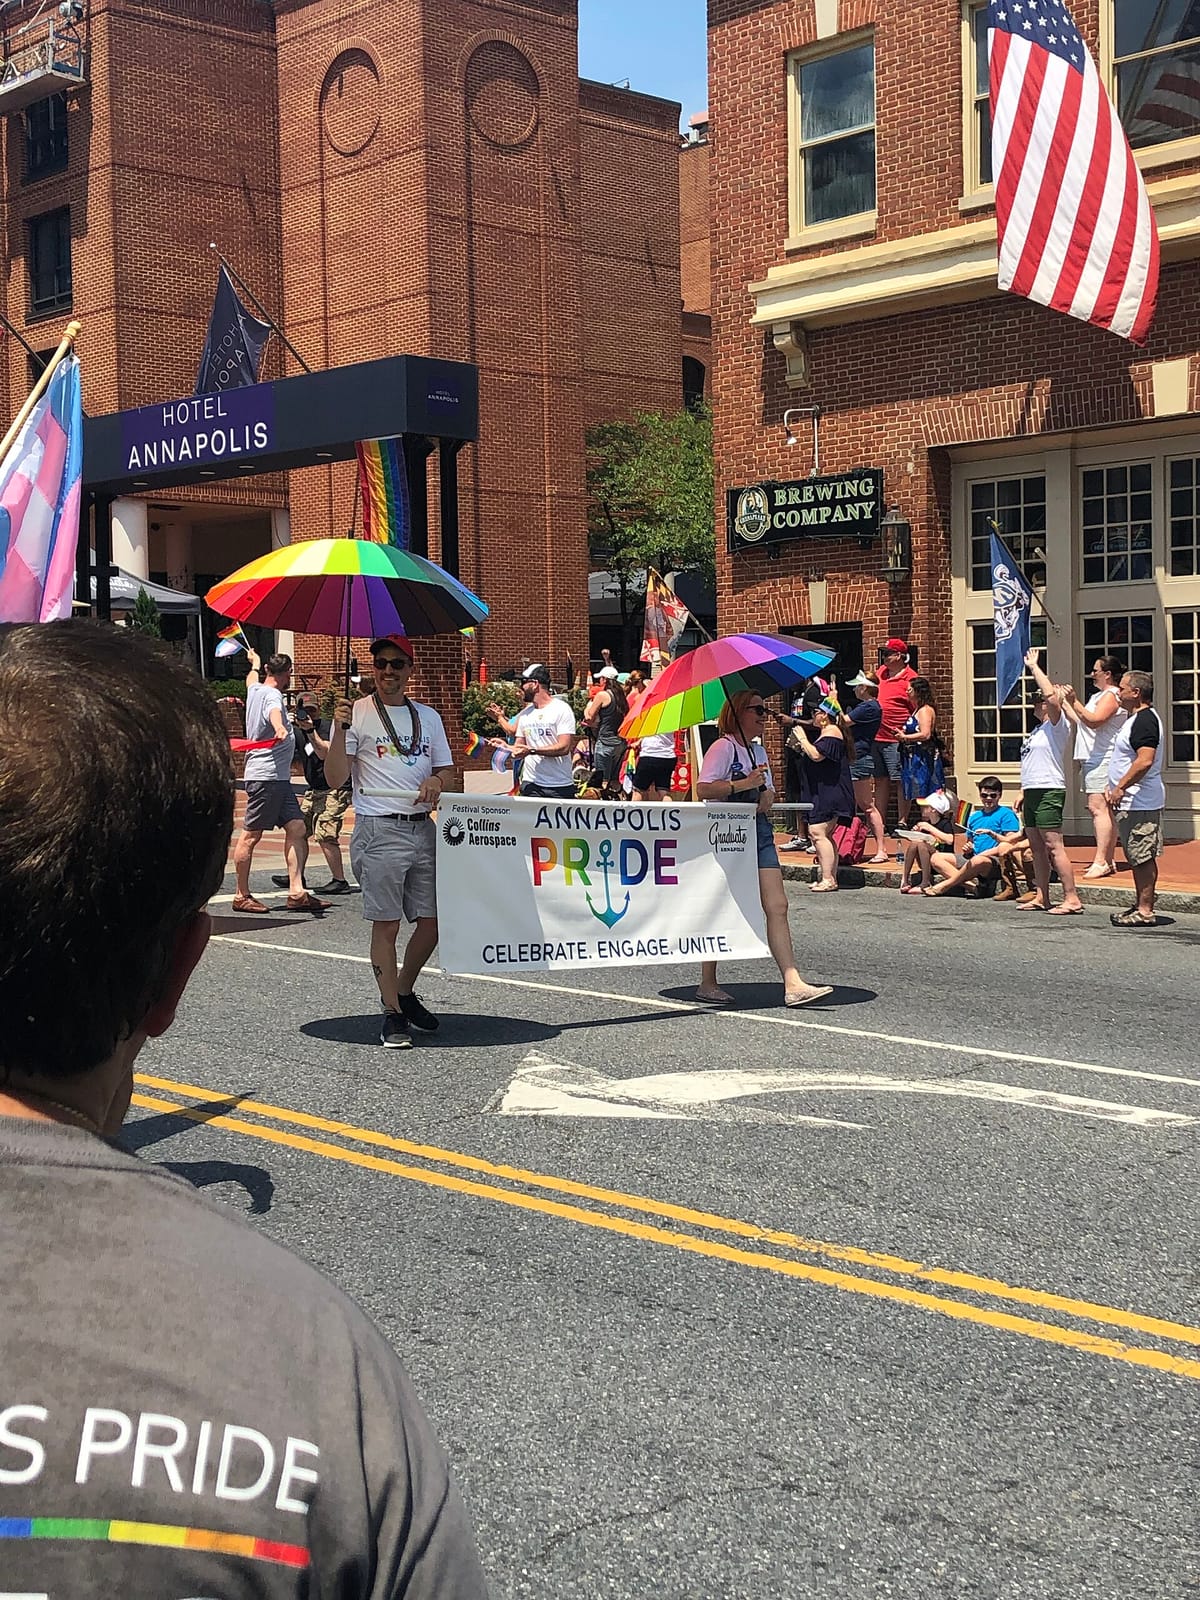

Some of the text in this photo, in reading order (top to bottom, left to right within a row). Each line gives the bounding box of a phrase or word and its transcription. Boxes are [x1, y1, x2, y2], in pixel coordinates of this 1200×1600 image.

[162, 396, 228, 427] HOTEL
[127, 422, 268, 470] ANNAPOLIS
[773, 477, 875, 507] BREWING
[772, 501, 876, 529] COMPANY
[452, 804, 511, 816] Festival Sponsor:
[535, 804, 681, 831] ANNAPOLIS
[707, 812, 726, 820] Parade
[467, 818, 501, 832] Collins
[708, 821, 748, 854] Graduate
[468, 832, 517, 849] Aerospace
[482, 935, 733, 965] CELEBRATE. ENGAGE. UNITE.
[75, 1406, 321, 1515] PRIDE
